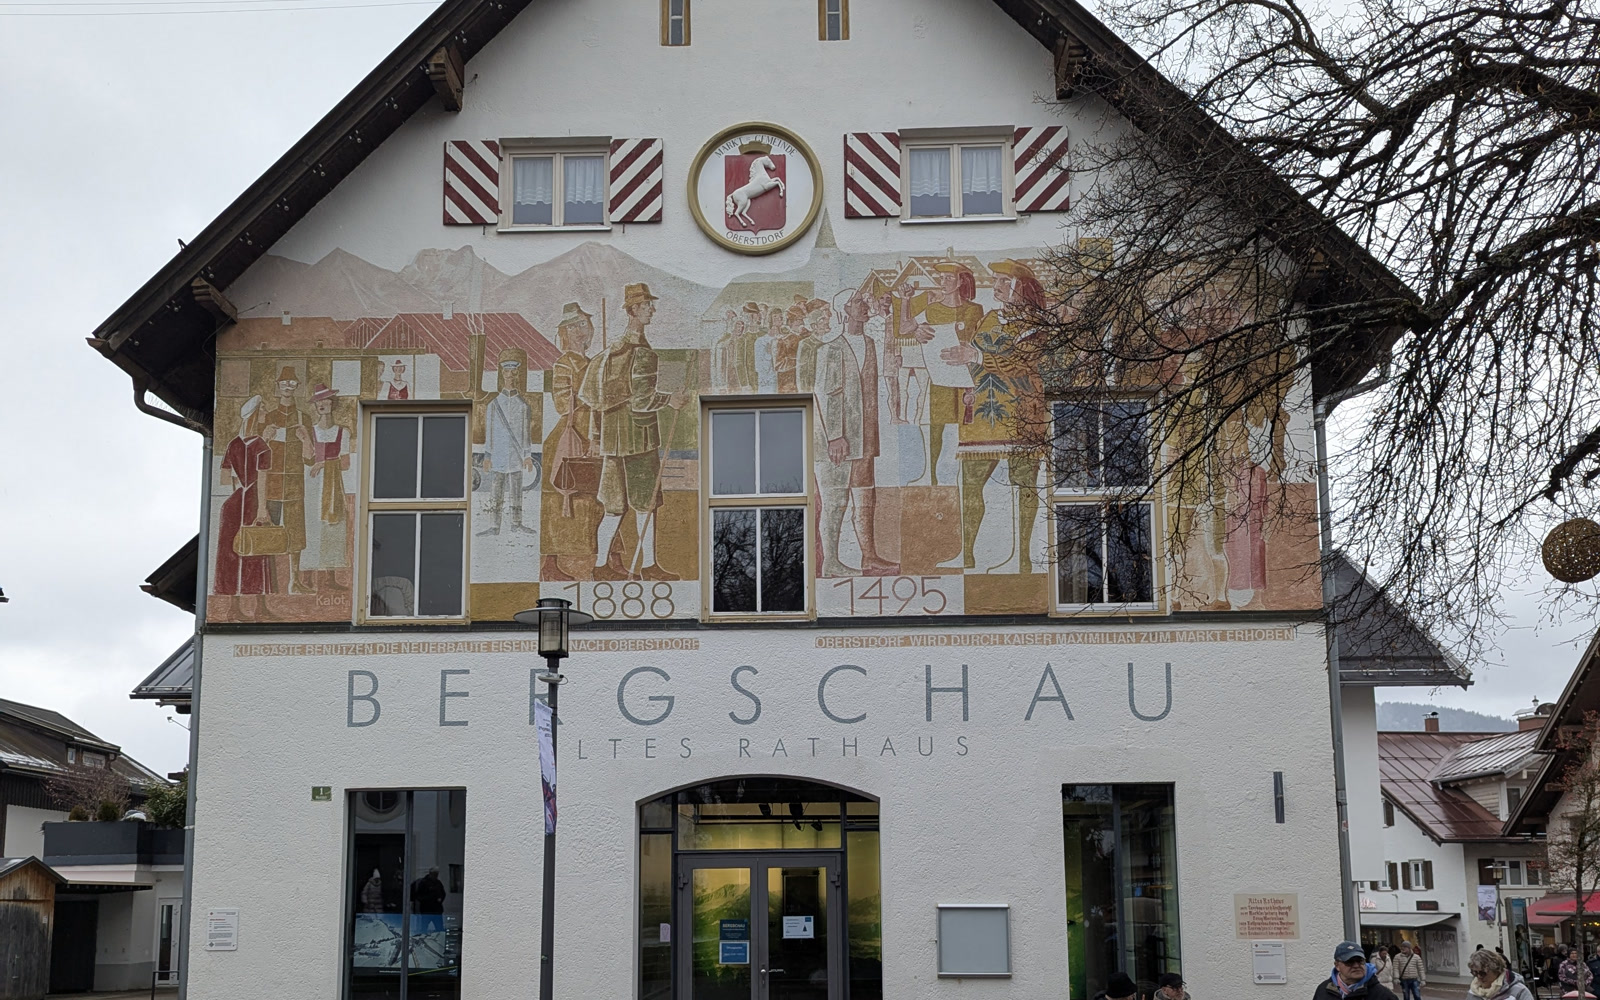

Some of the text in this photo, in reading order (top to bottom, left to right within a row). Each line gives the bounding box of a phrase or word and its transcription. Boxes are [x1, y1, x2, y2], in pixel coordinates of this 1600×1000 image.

[714, 134, 798, 158] MARKT GEMEINDE
[726, 229, 785, 245] OBERSTDORF
[563, 582, 675, 619] 1888
[832, 576, 947, 615] 1495
[305, 643, 373, 656] BENUTZEN
[376, 642, 397, 655] DIE
[401, 640, 488, 654] NEUERBAUTE
[491, 639, 538, 652] EISENB
[569, 639, 605, 651] NACH
[609, 638, 700, 651] OBERSTDORF
[815, 628, 1294, 649] OBERSTDORF WIRD DURCH KAISER MAXIMILIAN ZUM MARKT ERHOBEN
[739, 736, 969, 758] RATHAUS
[319, 787, 324, 795] 1
